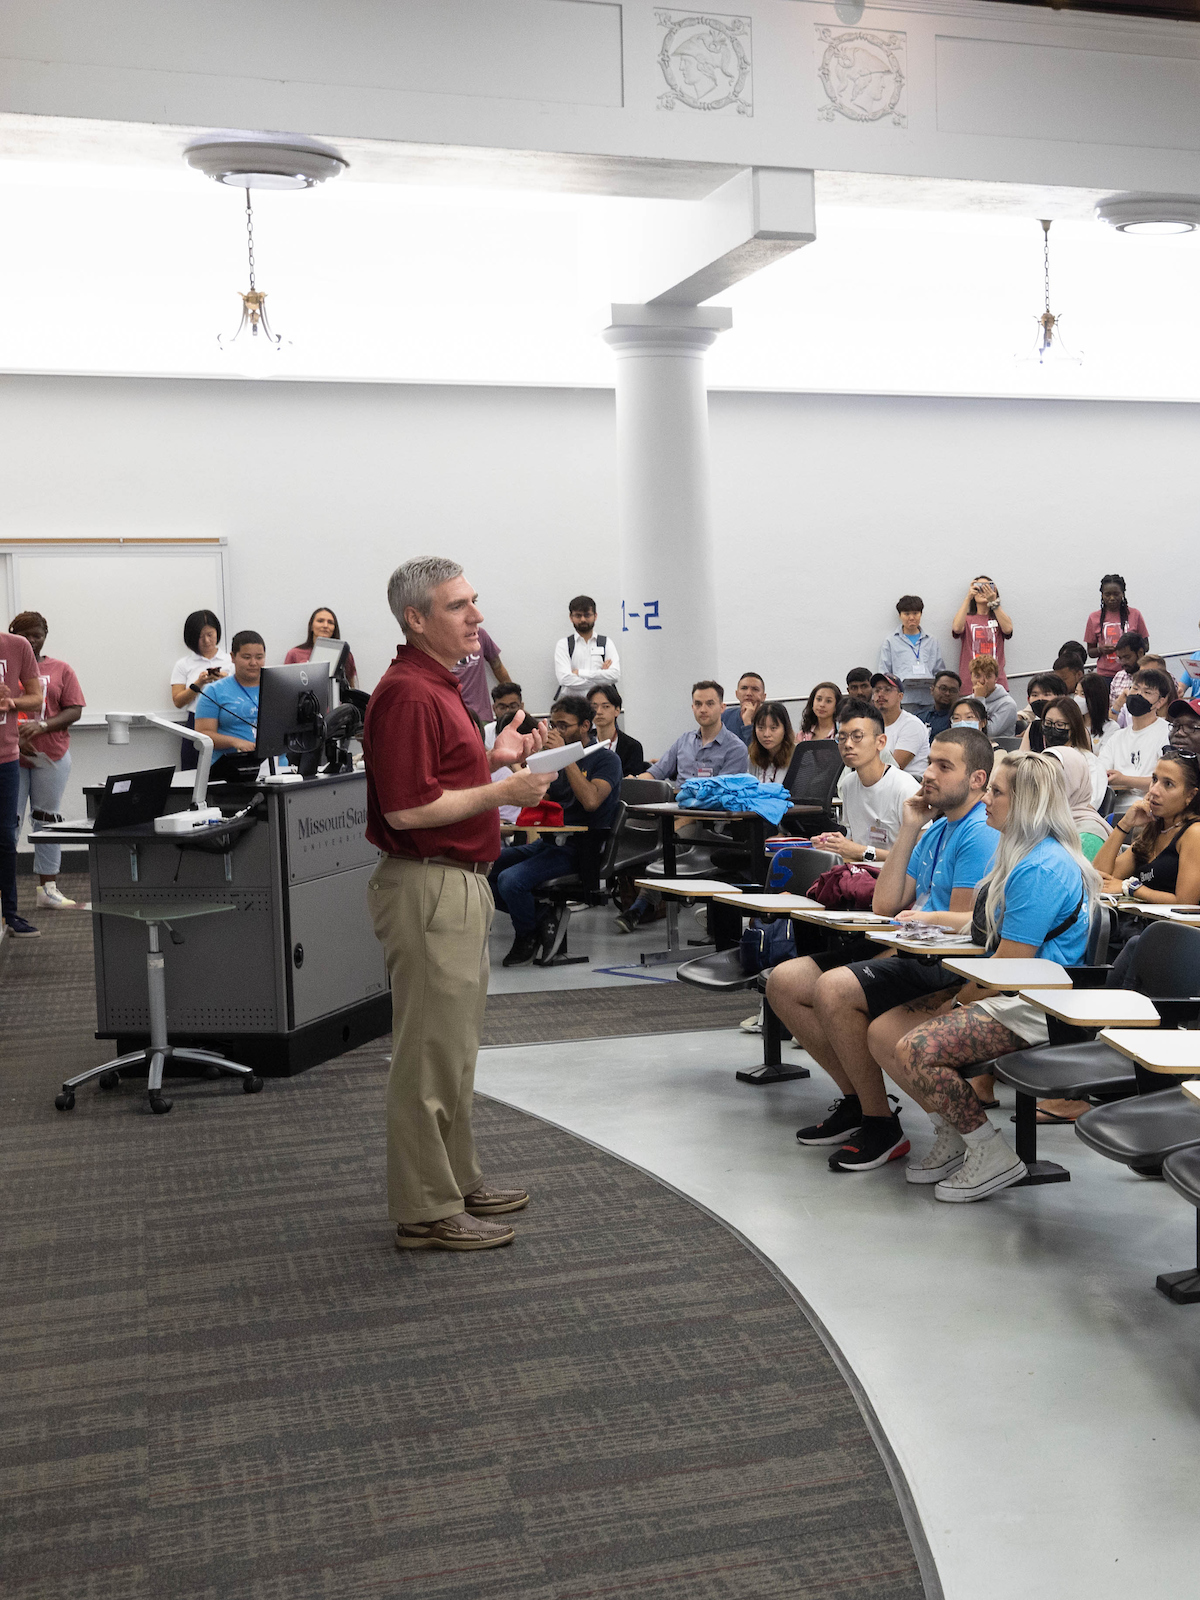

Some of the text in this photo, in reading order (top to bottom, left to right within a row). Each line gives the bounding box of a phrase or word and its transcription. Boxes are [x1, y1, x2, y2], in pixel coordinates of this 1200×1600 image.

[298, 806, 367, 840] Missouri Stat
[303, 832, 362, 853] UNIVERSIT
[770, 850, 793, 887] 5
